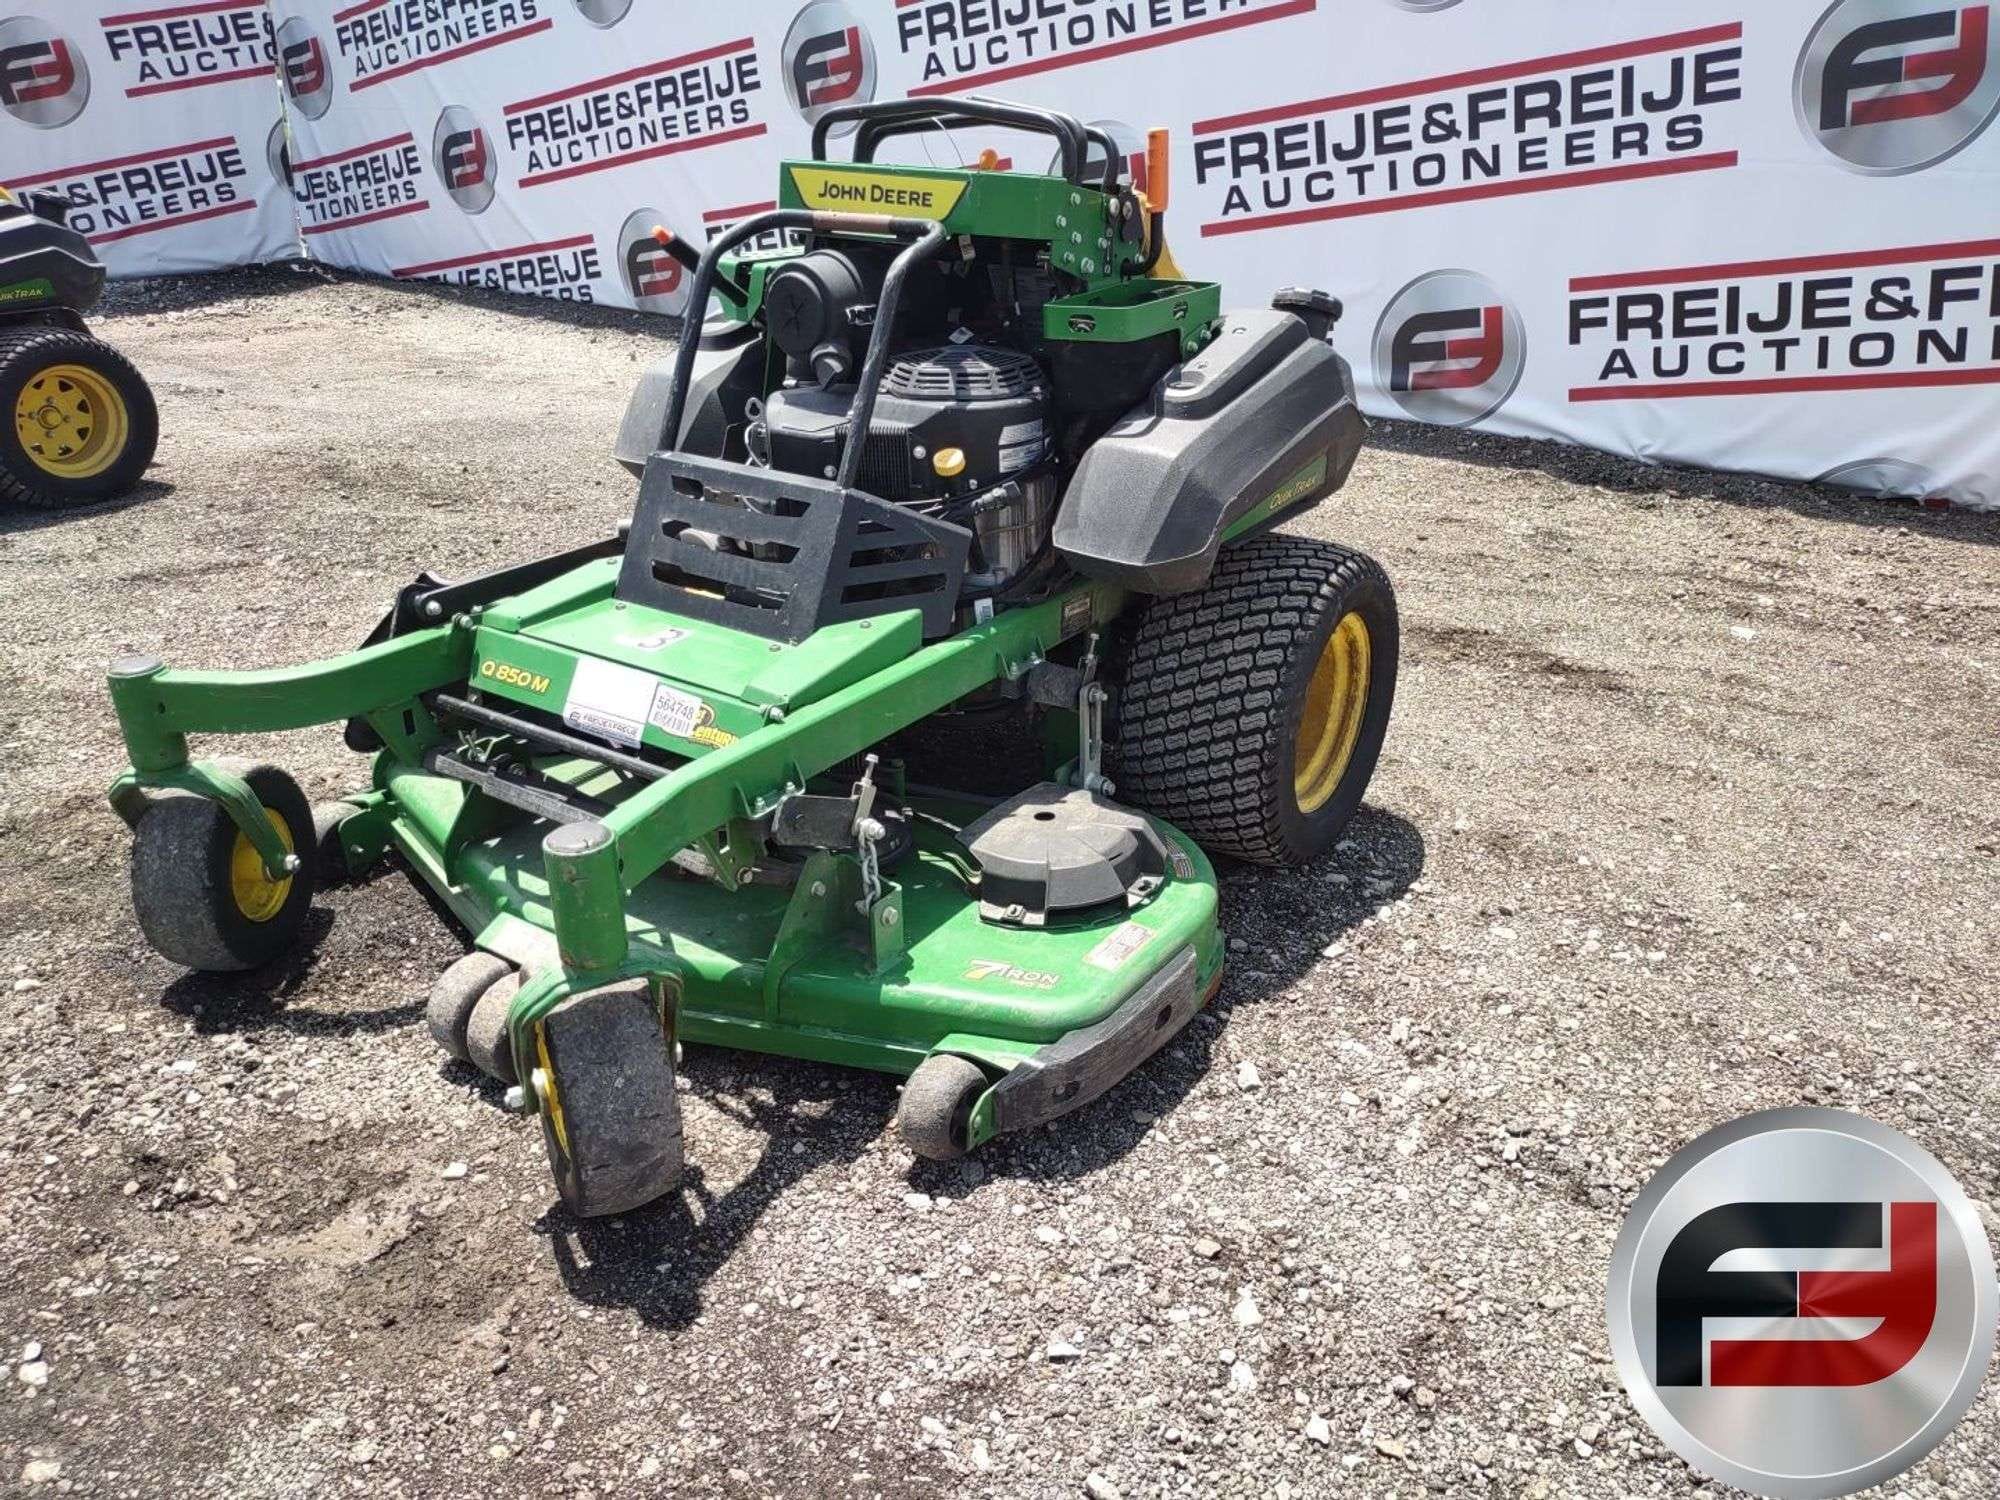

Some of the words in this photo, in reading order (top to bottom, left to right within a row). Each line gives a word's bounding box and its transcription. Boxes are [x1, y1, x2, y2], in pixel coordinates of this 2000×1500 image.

[506, 53, 761, 151] FREIJE&FREIJE
[527, 98, 750, 172] AUCTIONEERS
[1193, 46, 1743, 184] FREIJE&FREIJE
[306, 180, 417, 222] TIONEERS
[818, 180, 866, 202] JOHN
[870, 184, 934, 208] DEERE
[1221, 114, 1704, 216] AUCTIONEERS
[1569, 264, 2000, 345] FREIJE&F
[1599, 324, 2000, 380] AUCTION
